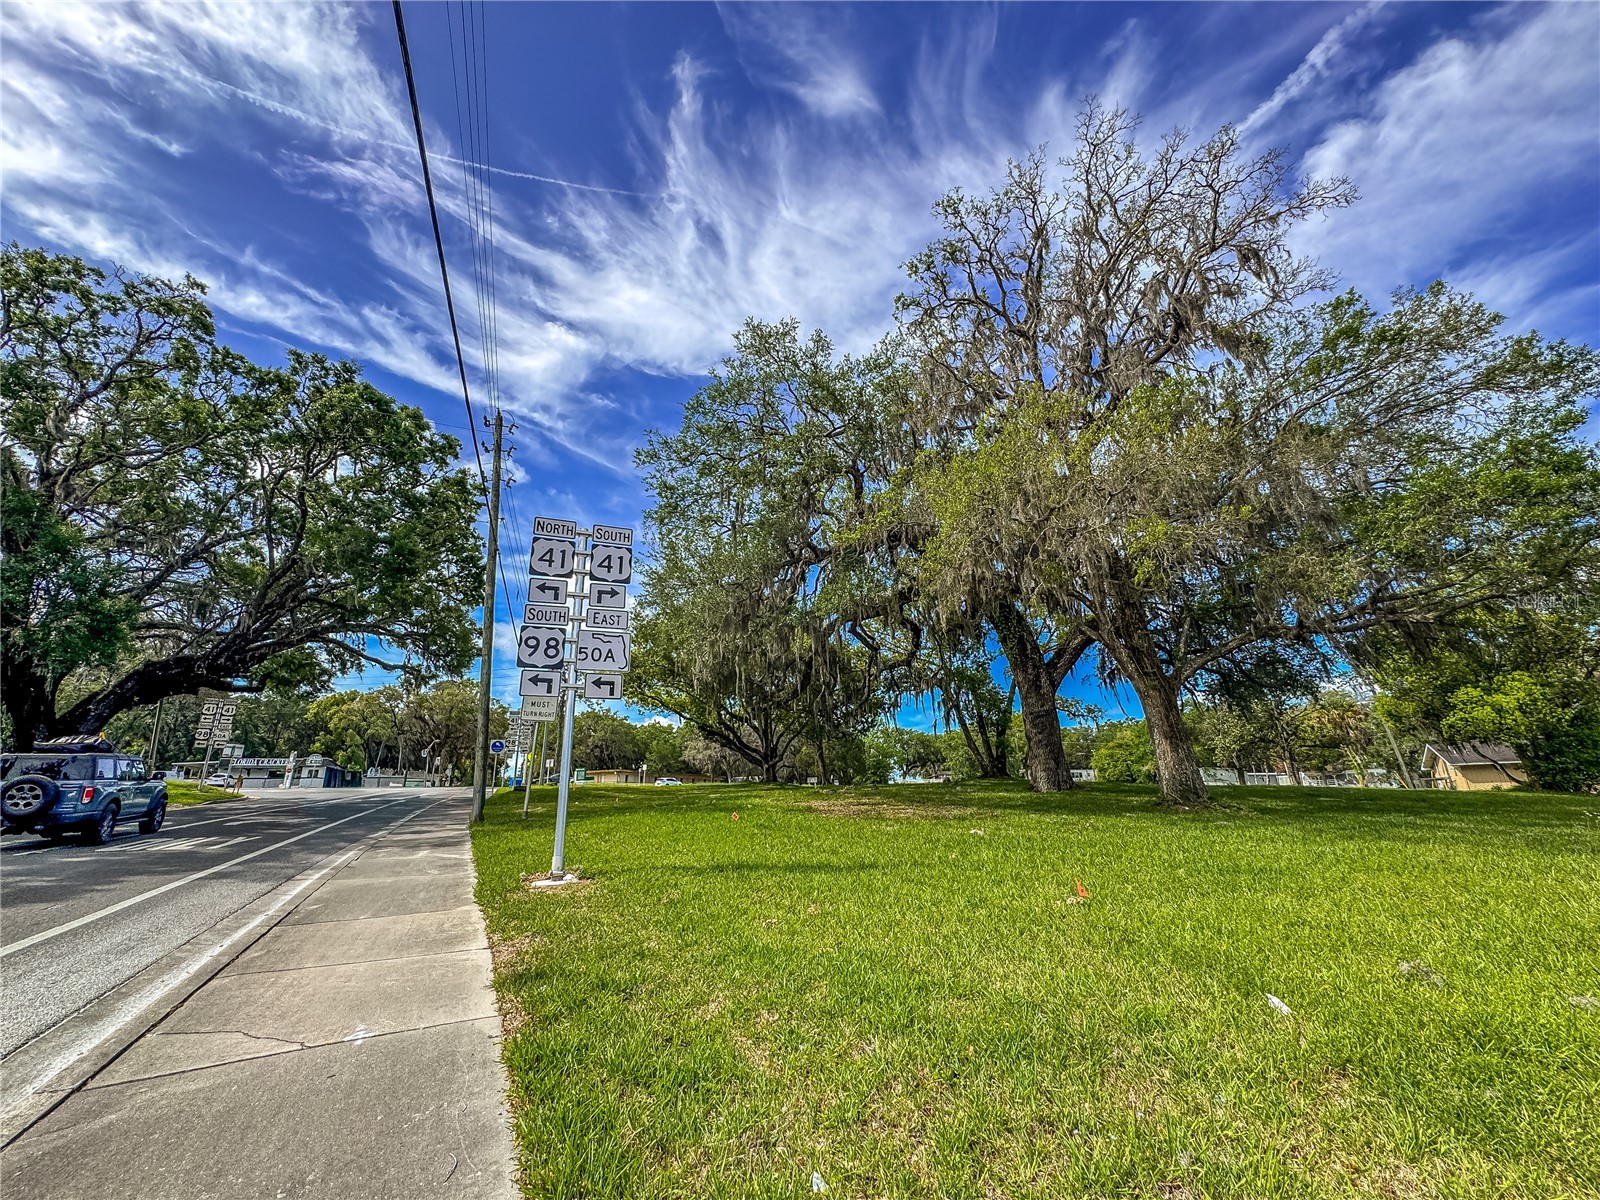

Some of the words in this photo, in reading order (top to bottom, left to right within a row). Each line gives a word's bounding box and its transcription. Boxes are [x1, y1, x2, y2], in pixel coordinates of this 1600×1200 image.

[536, 520, 574, 536] NORTH
[595, 528, 630, 542] SOUTH
[538, 548, 567, 569] 41
[597, 554, 624, 574] 41
[527, 608, 566, 626] SOUTH
[593, 612, 622, 626] EAST
[524, 636, 560, 659] 98
[578, 647, 615, 662] 50A
